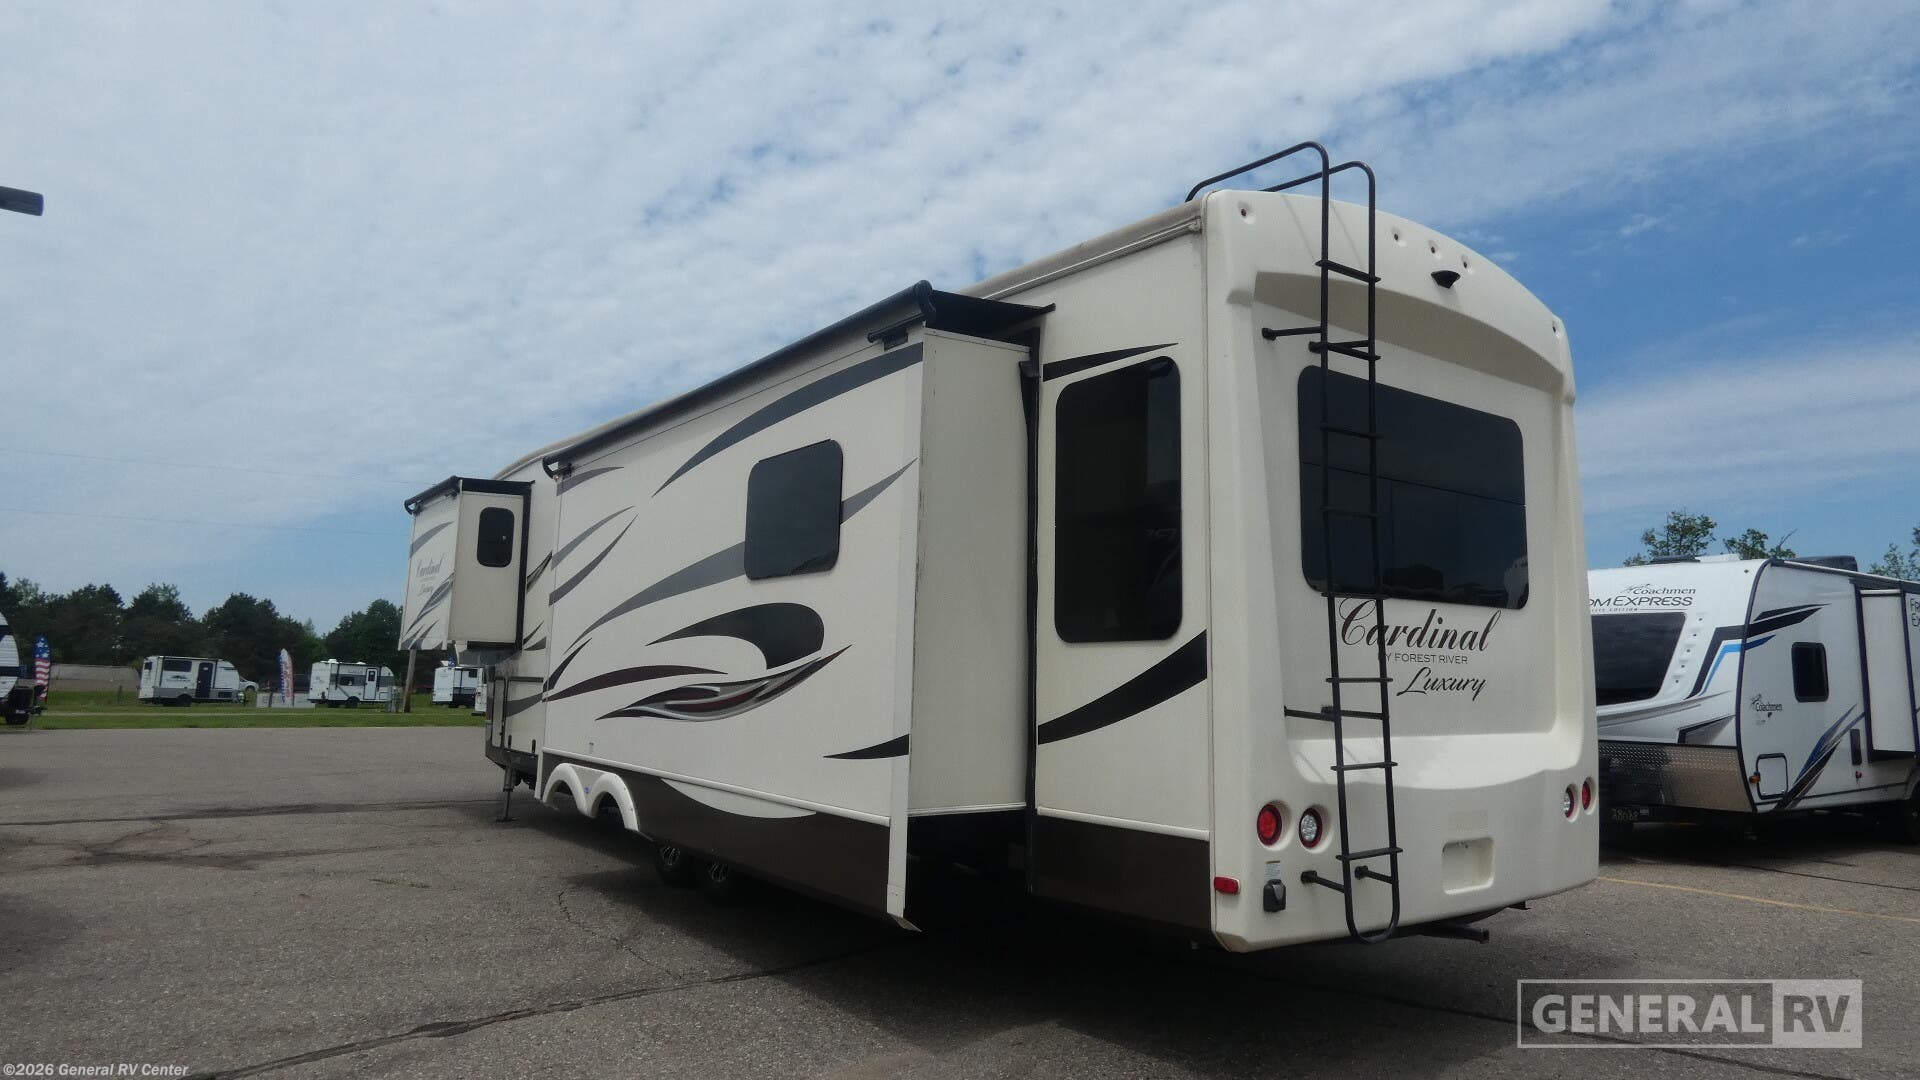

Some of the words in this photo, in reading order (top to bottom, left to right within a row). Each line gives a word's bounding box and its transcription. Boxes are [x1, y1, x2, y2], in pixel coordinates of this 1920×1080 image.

[1633, 587, 1696, 595] Coachmen
[1613, 595, 1694, 607] EXPRESS
[1339, 597, 1502, 652] Cardinal
[1394, 652, 1437, 663] FOREST
[1438, 654, 1468, 664] RIVER
[1396, 666, 1486, 702] Luxury
